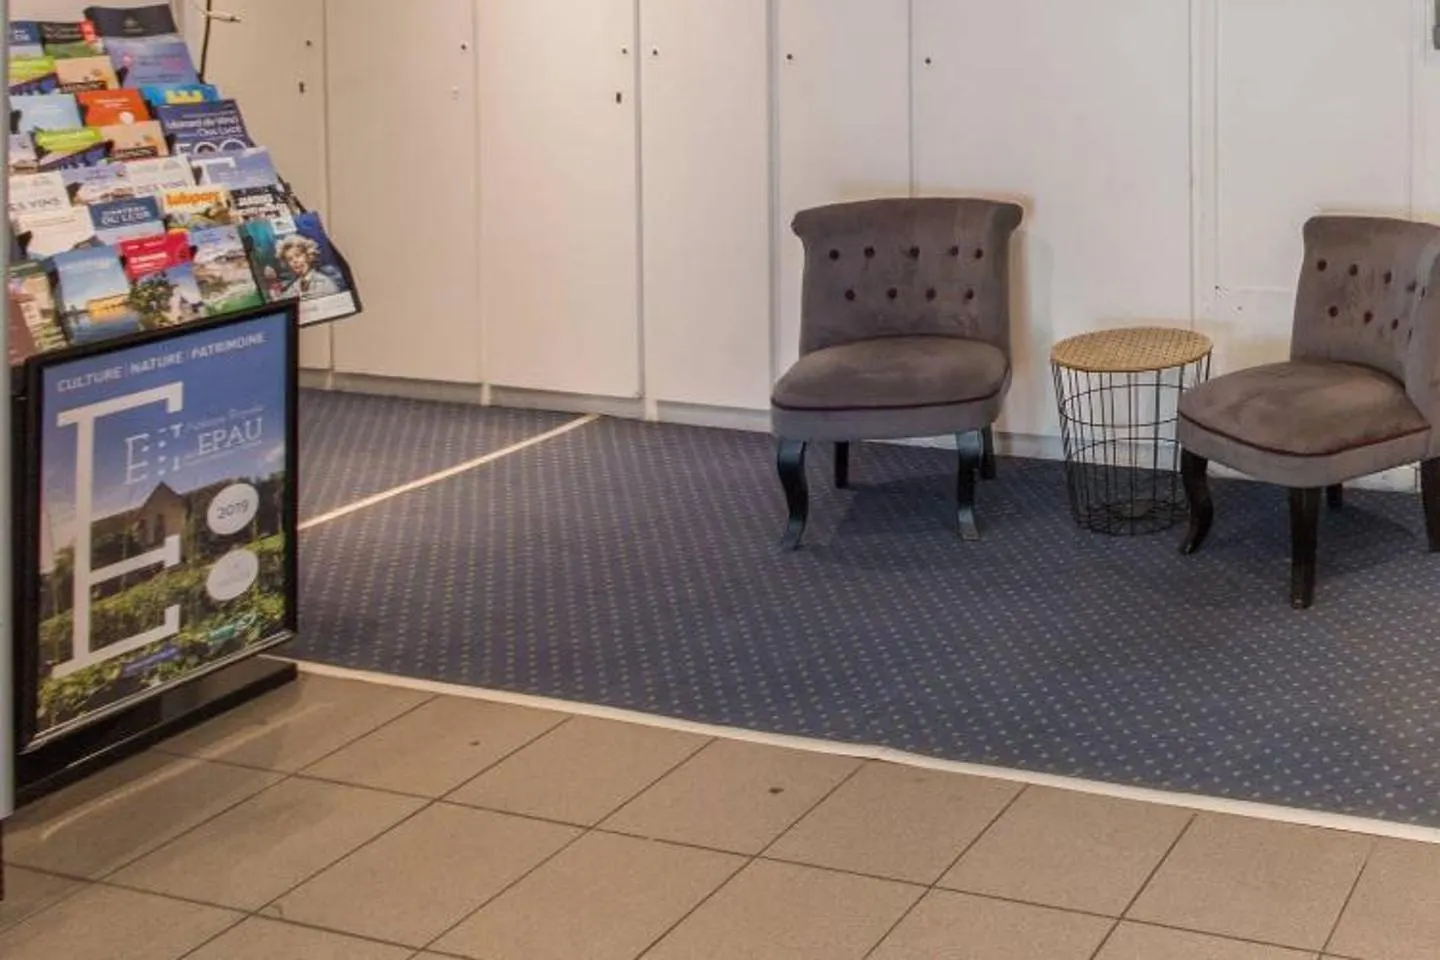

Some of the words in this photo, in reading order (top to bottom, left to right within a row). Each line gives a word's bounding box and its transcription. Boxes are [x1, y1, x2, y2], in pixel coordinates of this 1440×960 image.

[57, 366, 123, 392] CULTURE
[130, 351, 184, 374] NATURE
[191, 332, 267, 359] PATRIMOINE
